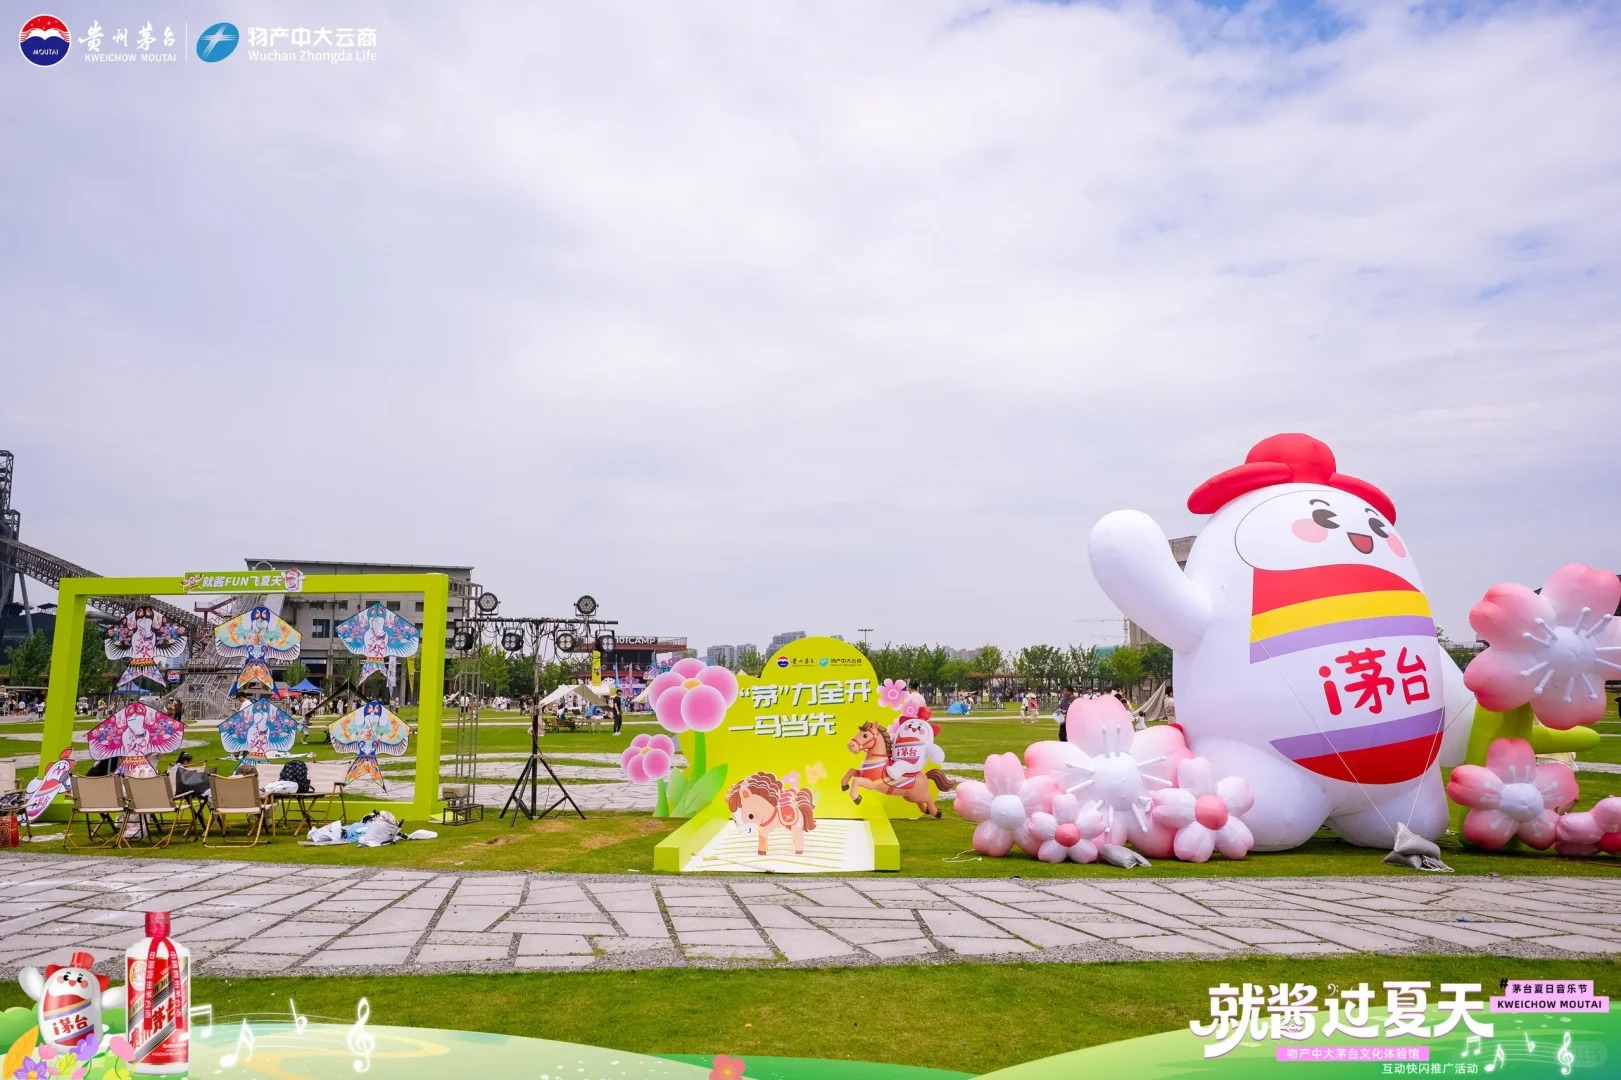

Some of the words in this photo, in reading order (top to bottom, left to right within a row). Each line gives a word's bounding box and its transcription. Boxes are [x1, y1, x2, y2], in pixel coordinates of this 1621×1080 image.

[1318, 647, 1430, 717] i茅台
[728, 712, 836, 738] 一马当先
